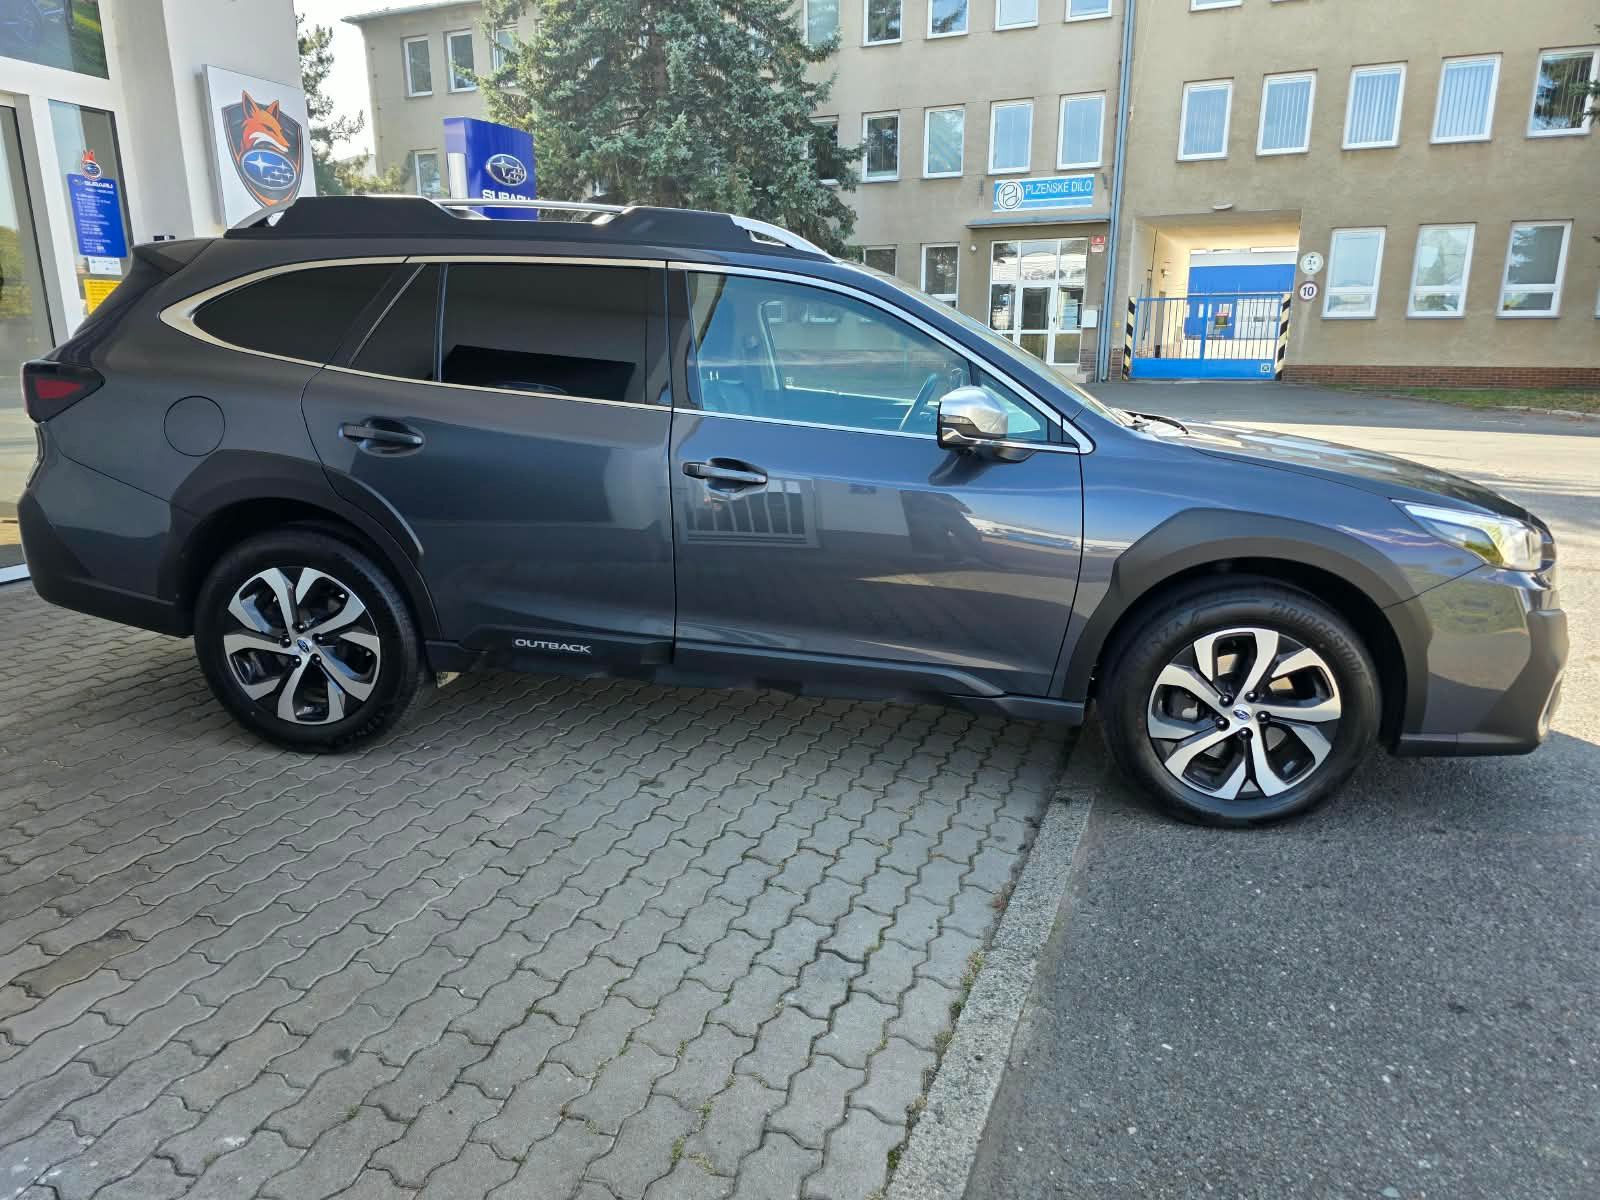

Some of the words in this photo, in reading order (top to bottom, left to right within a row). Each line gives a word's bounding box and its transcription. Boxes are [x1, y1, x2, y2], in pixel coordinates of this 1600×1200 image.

[1025, 180, 1069, 195] PLZEŇSKÉ
[1072, 179, 1092, 192] DÍLO
[1303, 286, 1315, 297] 10
[514, 638, 592, 654] OUTBACK
